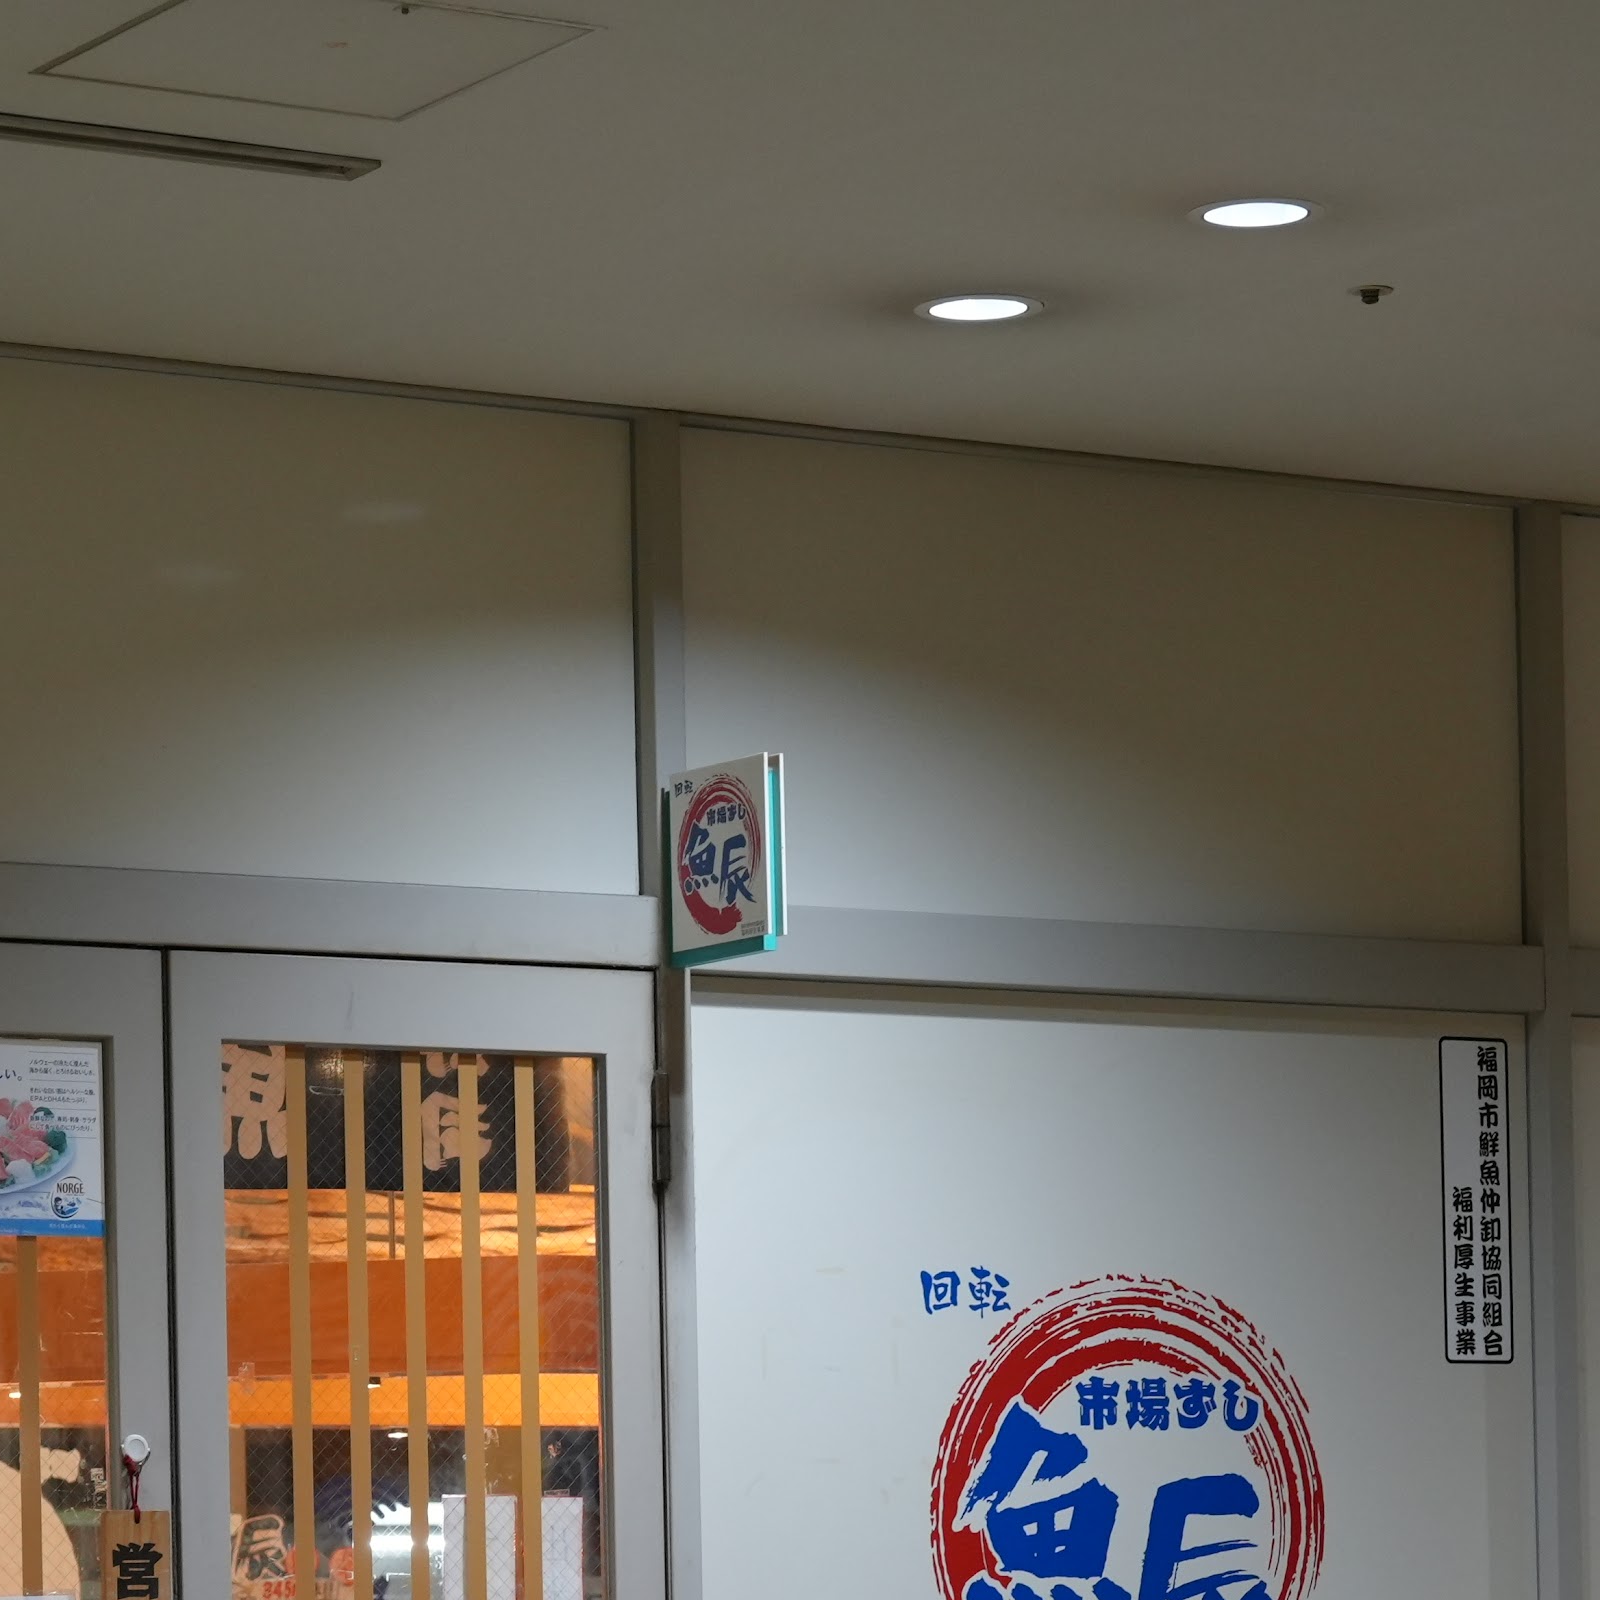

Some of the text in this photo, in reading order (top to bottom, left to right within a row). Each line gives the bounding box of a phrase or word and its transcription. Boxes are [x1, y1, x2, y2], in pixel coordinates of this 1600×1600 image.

[684, 821, 757, 906] 魚辰
[57, 1183, 84, 1194] NORGE
[1476, 1046, 1503, 1356] 福岡市鮮魚仲卸協同組合
[920, 1266, 1012, 1318] 回転
[1453, 1186, 1475, 1355] 福利厚生事業
[1075, 1377, 1259, 1432] 市場ずし
